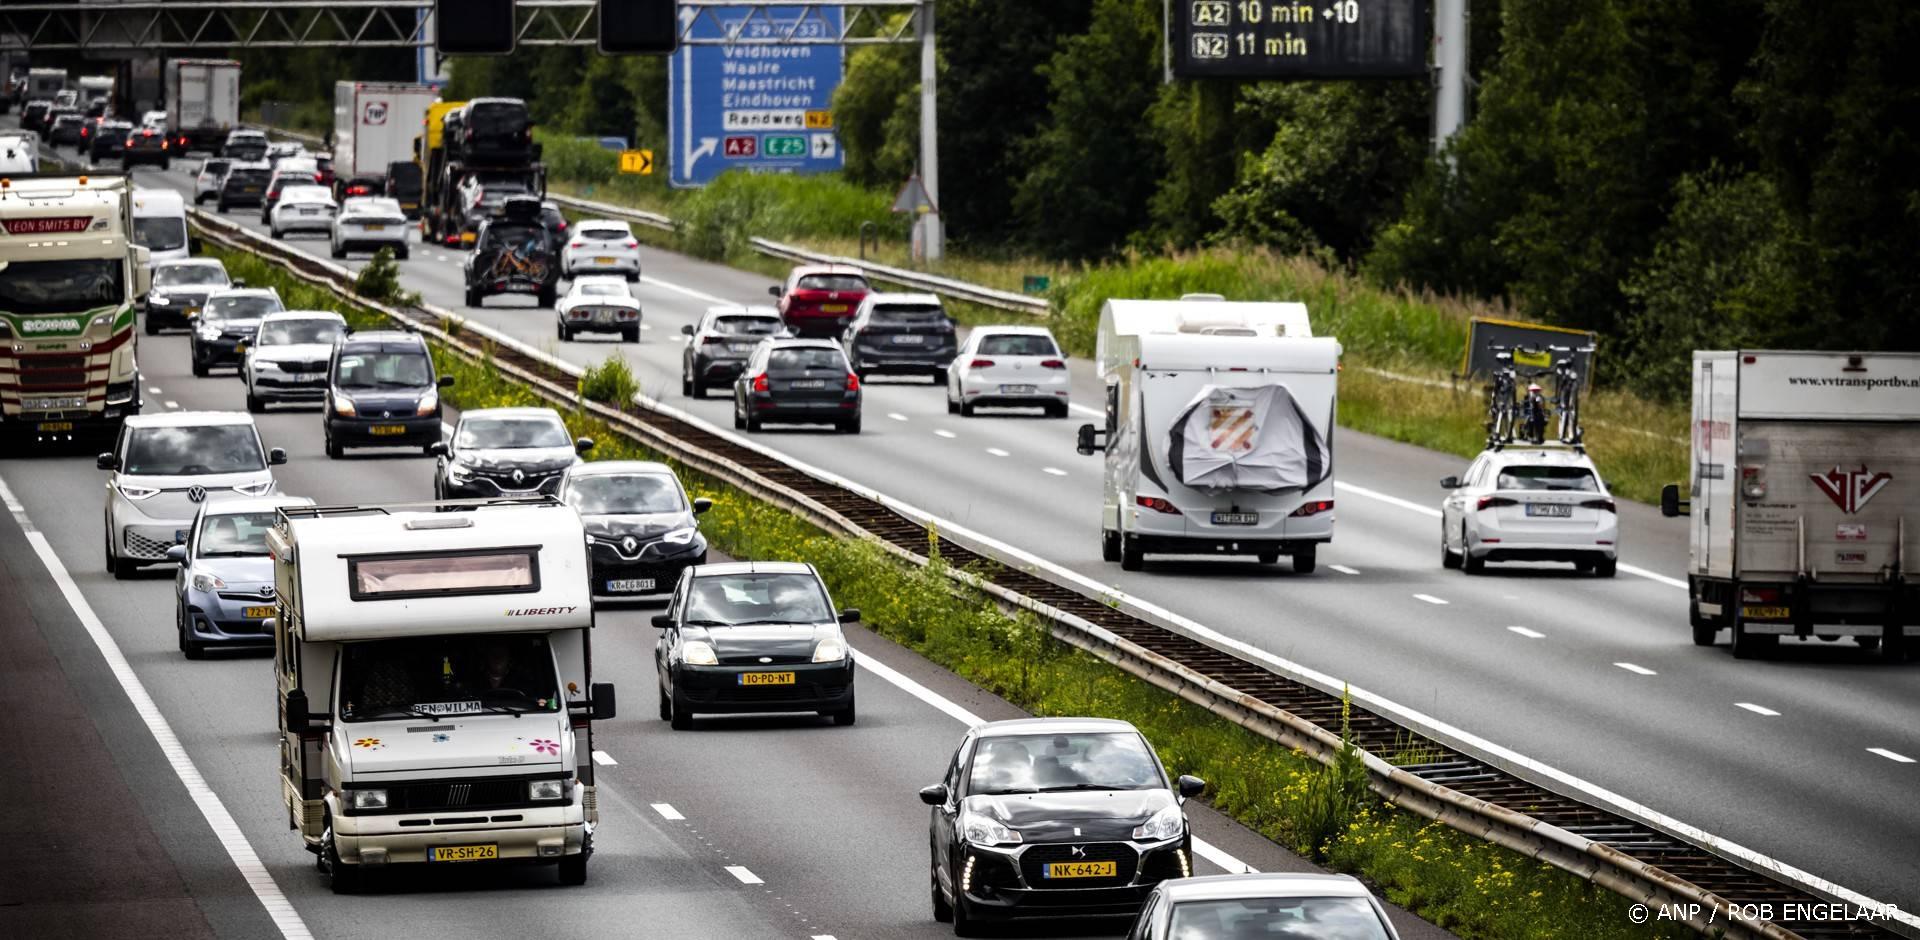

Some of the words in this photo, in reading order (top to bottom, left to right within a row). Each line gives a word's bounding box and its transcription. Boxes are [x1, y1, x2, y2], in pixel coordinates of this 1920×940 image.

[1197, 4, 1227, 23] A2
[1238, 2, 1262, 23] 10
[1271, 1, 1313, 23] min
[1322, 1, 1359, 23] +10
[1197, 36, 1225, 56] N2
[1236, 33, 1256, 55] 11
[1265, 32, 1307, 55] min
[722, 45, 811, 58] Veldhoven
[722, 61, 780, 75] Waalre
[722, 77, 816, 91] Maastricht
[722, 94, 812, 107] Eindhoven
[728, 113, 803, 126] Randweg
[807, 114, 830, 125] N2
[728, 140, 754, 154] A2
[8, 221, 35, 233] LEON
[38, 219, 70, 232] SMITS
[73, 218, 88, 230] BV
[515, 606, 577, 616] LIBERTY
[746, 673, 792, 684] 10-PD-NT
[444, 701, 481, 713] WILMA
[437, 846, 494, 859] VR-SH-26
[1054, 863, 1112, 876] NK-642-J
